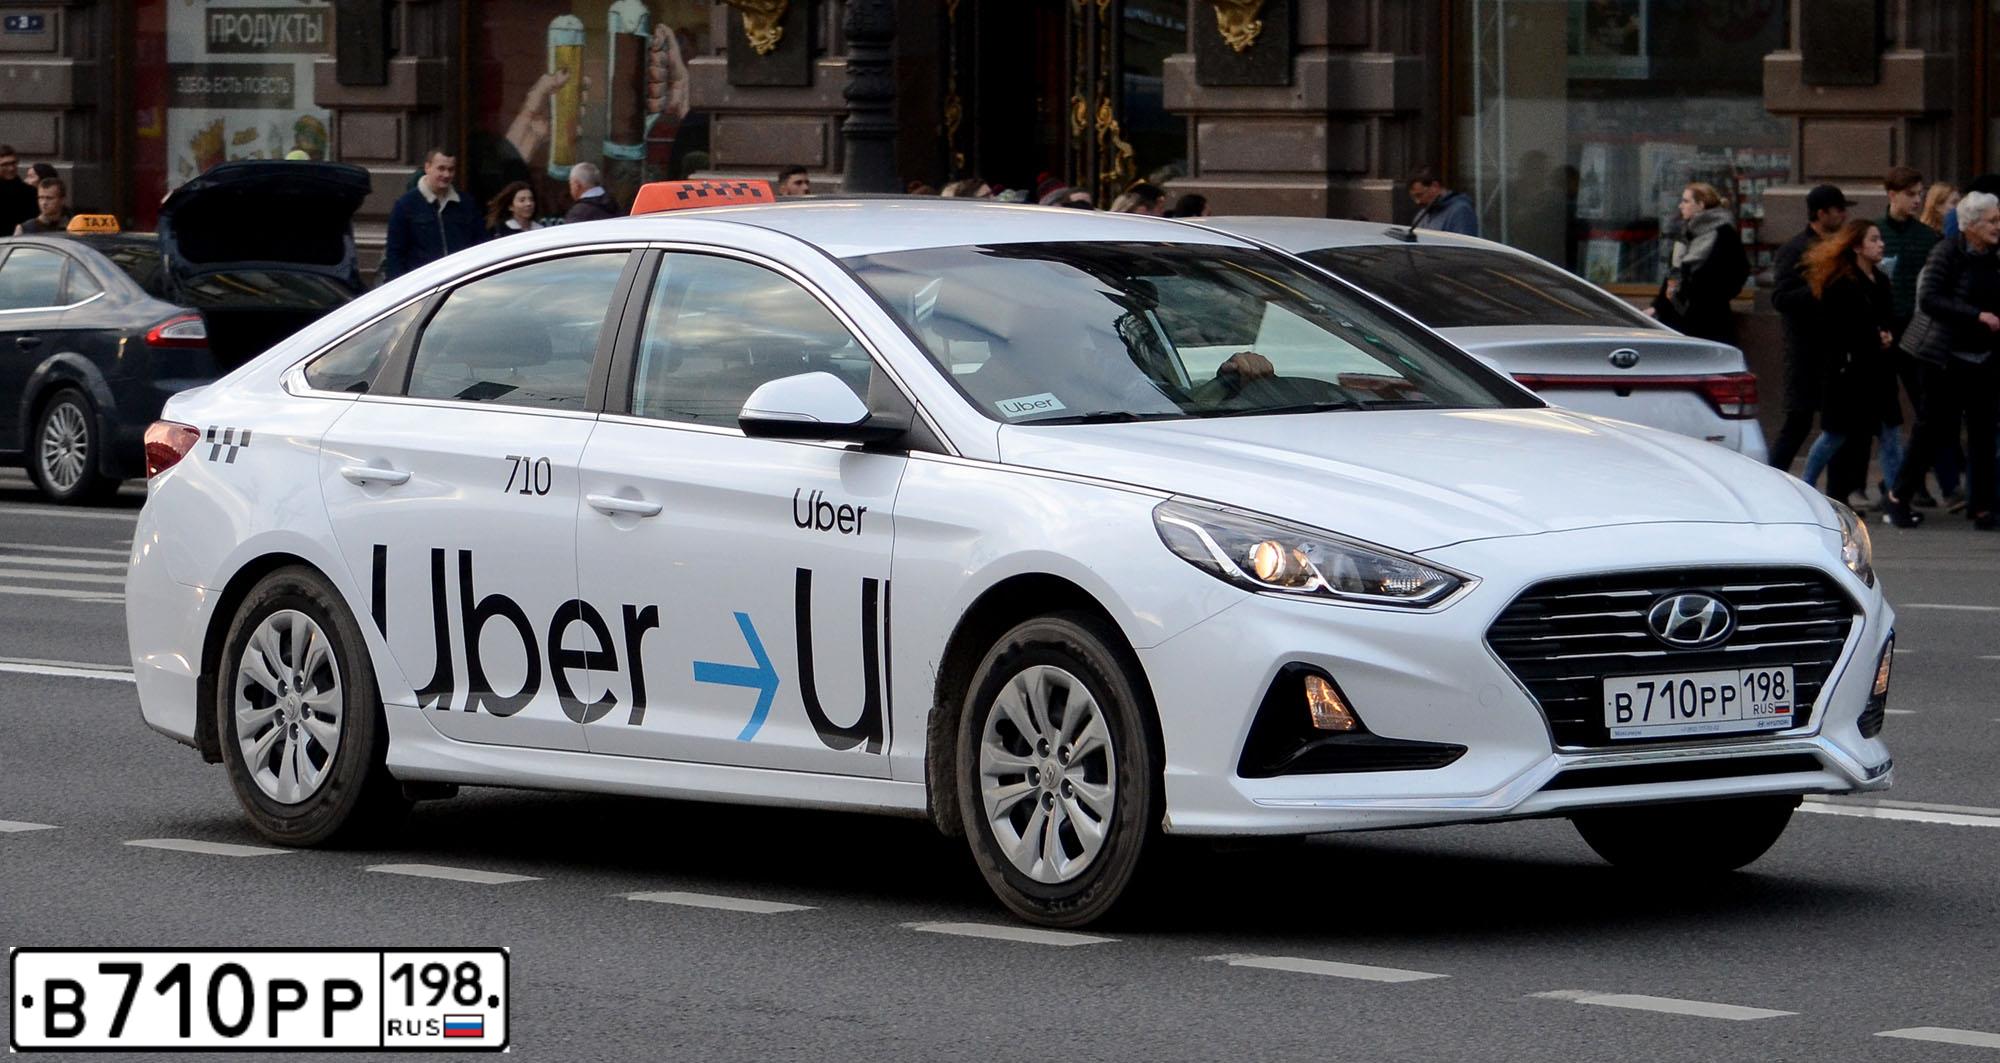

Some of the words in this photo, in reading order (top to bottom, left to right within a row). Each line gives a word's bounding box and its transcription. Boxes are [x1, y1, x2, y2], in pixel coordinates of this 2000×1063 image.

[211, 13, 324, 47] ПРОДУКТЫ
[1003, 398, 1053, 413] Uber
[503, 454, 553, 496] 710
[793, 487, 868, 535] Uber
[371, 543, 660, 725] Uber
[1743, 671, 1785, 702] 198
[1753, 703, 1774, 714] RUS
